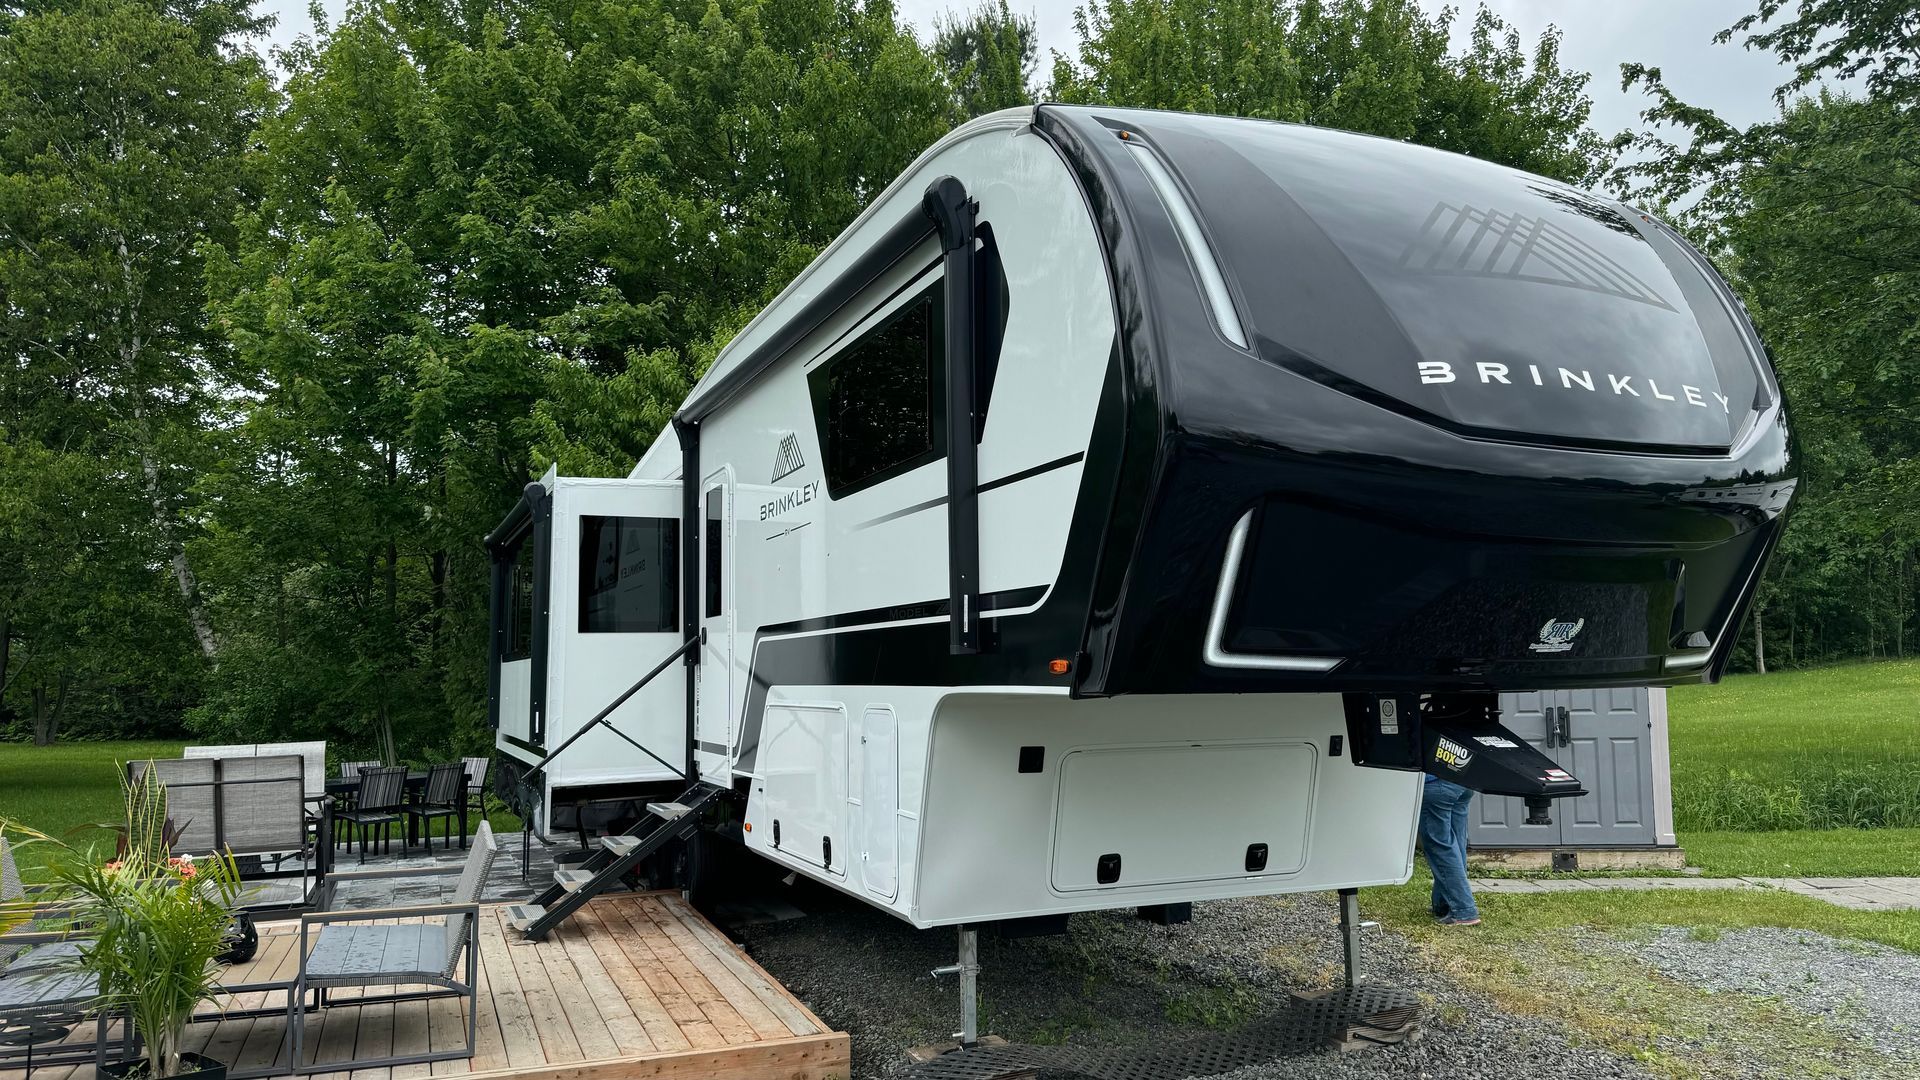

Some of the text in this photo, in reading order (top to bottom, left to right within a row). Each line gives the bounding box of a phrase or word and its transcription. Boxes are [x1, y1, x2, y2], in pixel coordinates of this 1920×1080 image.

[1416, 360, 1730, 414] BRINKLEY
[760, 480, 819, 521] BRINKLEY
[1435, 747, 1457, 766] BOX
[1438, 737, 1468, 759] RHINO
